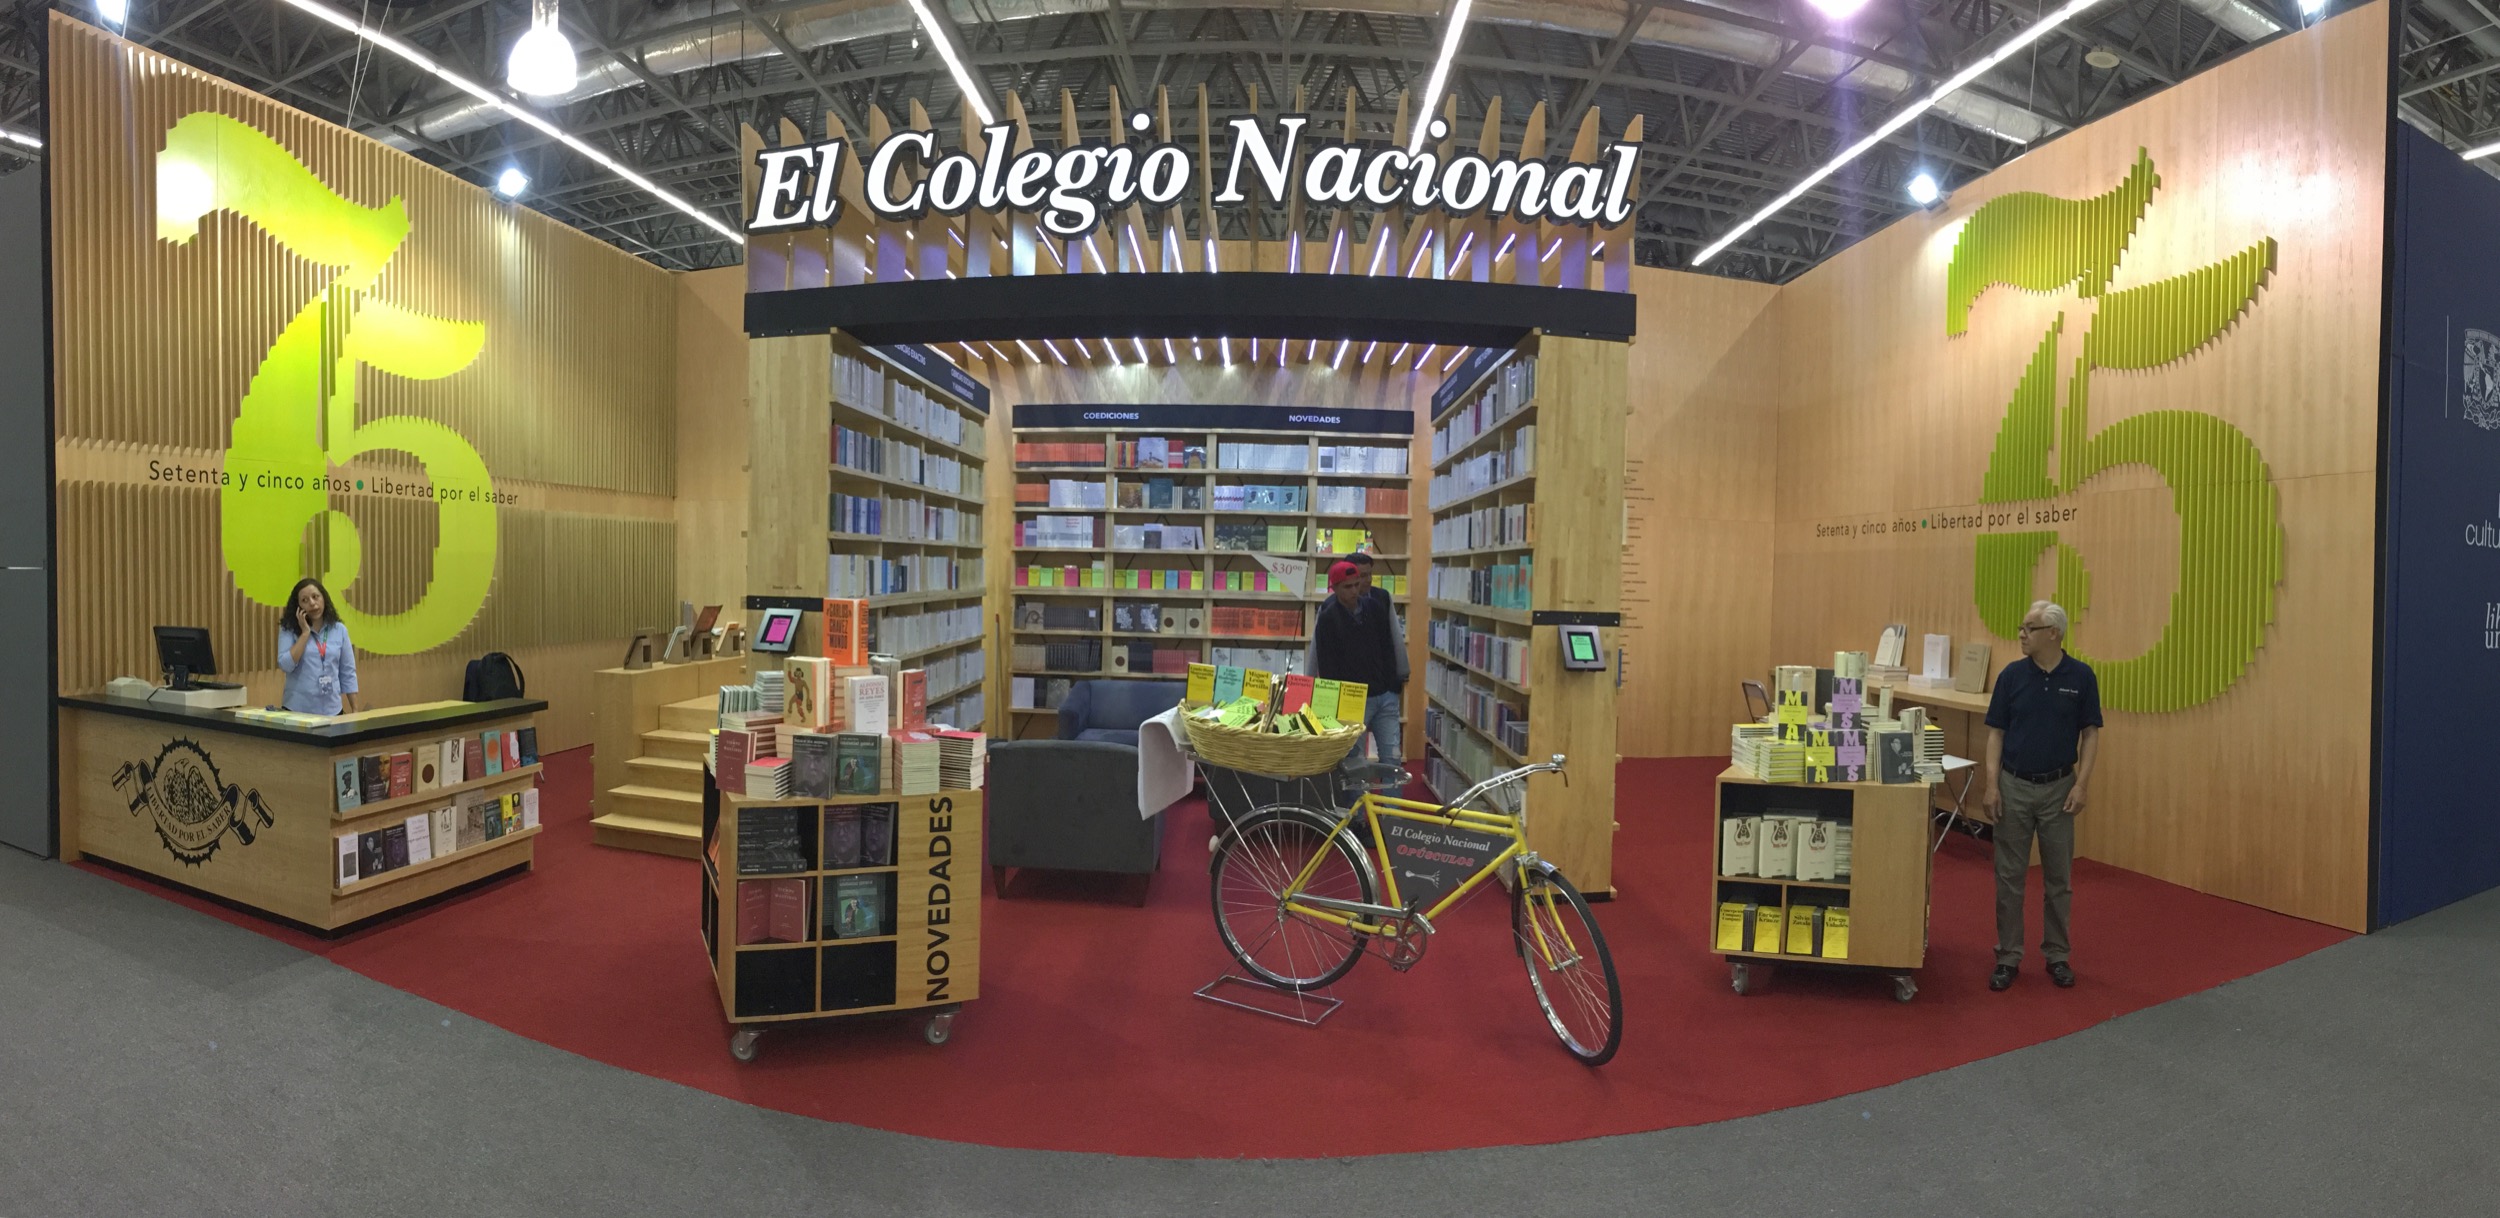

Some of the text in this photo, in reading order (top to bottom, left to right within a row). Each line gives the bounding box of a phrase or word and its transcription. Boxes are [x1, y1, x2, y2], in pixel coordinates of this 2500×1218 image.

[747, 112, 1641, 235] El Colegio Nacional
[1083, 411, 1139, 421] COEDICIONES
[1288, 414, 1341, 424] NOVEDADES
[148, 459, 518, 506] Setenta y cinco años Libertad por el saber
[1816, 504, 2078, 539] Setenta y cinco años Libertad por el saber
[1245, 682, 1269, 690] Portilla
[1248, 671, 1269, 679] Miguel
[859, 687, 885, 696] REYES
[146, 785, 231, 842] LIBERTAD POR EL SABER
[1391, 825, 1491, 852] El Colegio Nacional
[926, 796, 953, 1002] NOVEDADES
